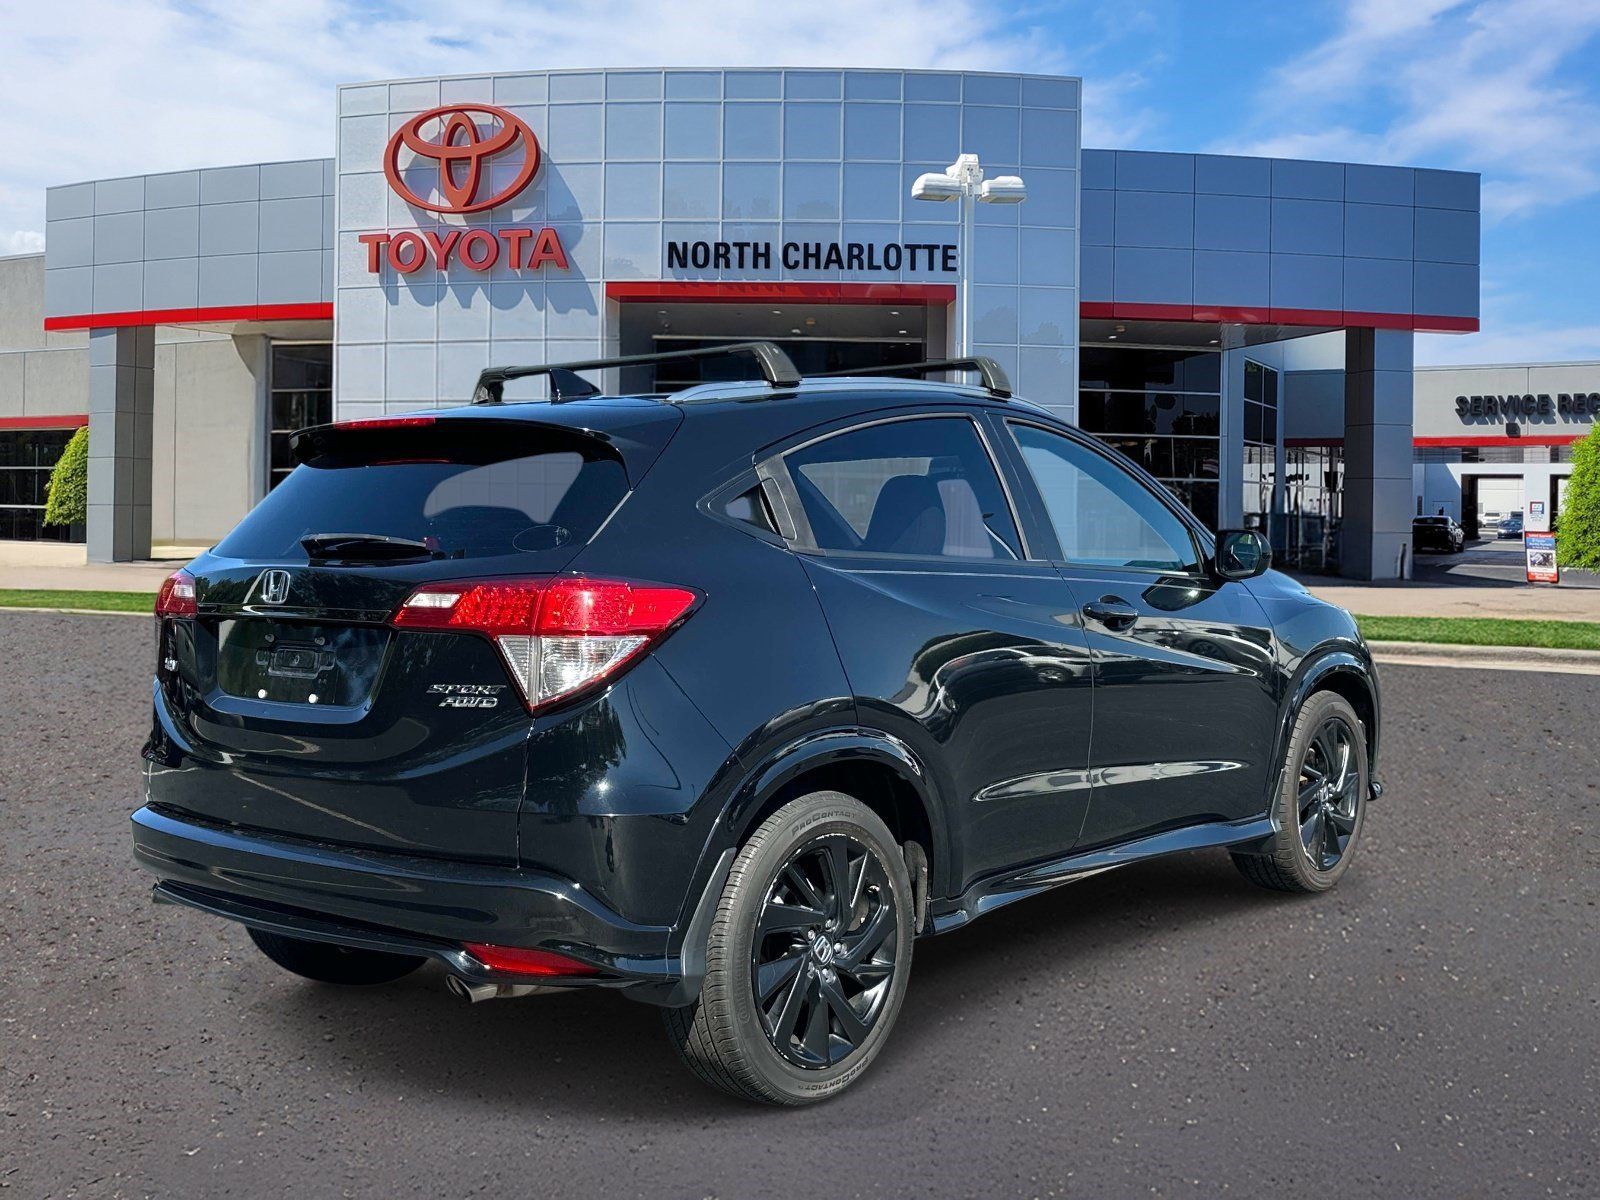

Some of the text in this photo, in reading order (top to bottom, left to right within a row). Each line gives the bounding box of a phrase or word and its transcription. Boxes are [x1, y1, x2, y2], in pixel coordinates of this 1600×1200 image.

[358, 227, 569, 274] TOYOTA
[667, 241, 958, 272] NORTH CHARLOTTE
[1455, 393, 1550, 417] SERVICE
[426, 684, 507, 694] SPORT
[439, 697, 498, 708] AWD
